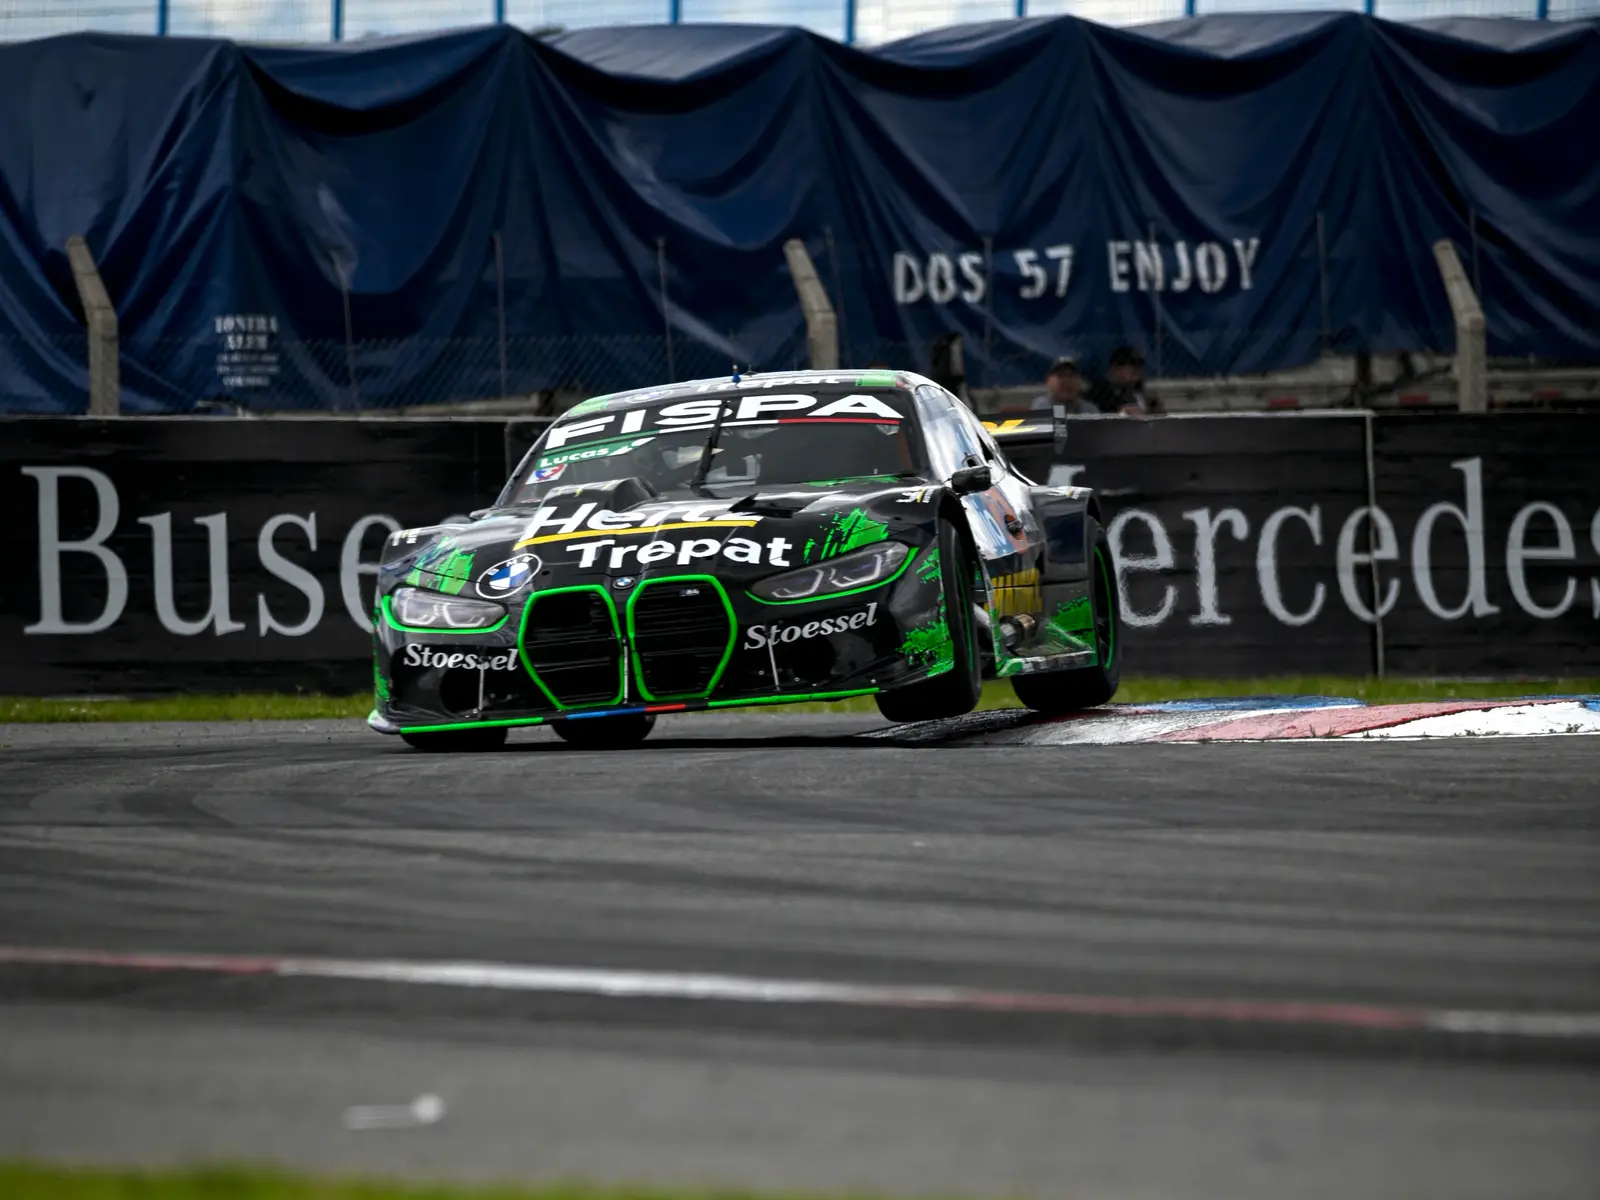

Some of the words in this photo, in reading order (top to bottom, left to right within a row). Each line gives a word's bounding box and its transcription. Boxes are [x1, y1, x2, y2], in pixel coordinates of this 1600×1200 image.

[893, 250, 988, 305] DOS
[1014, 244, 1073, 300] 57
[1107, 237, 1260, 294] ENJOY
[545, 394, 904, 449] FISPA
[540, 447, 609, 467] Lucas
[518, 502, 764, 543] Hertz
[1045, 456, 1600, 630] ercede
[567, 537, 792, 569] Trepat
[744, 602, 878, 651] Stoessel
